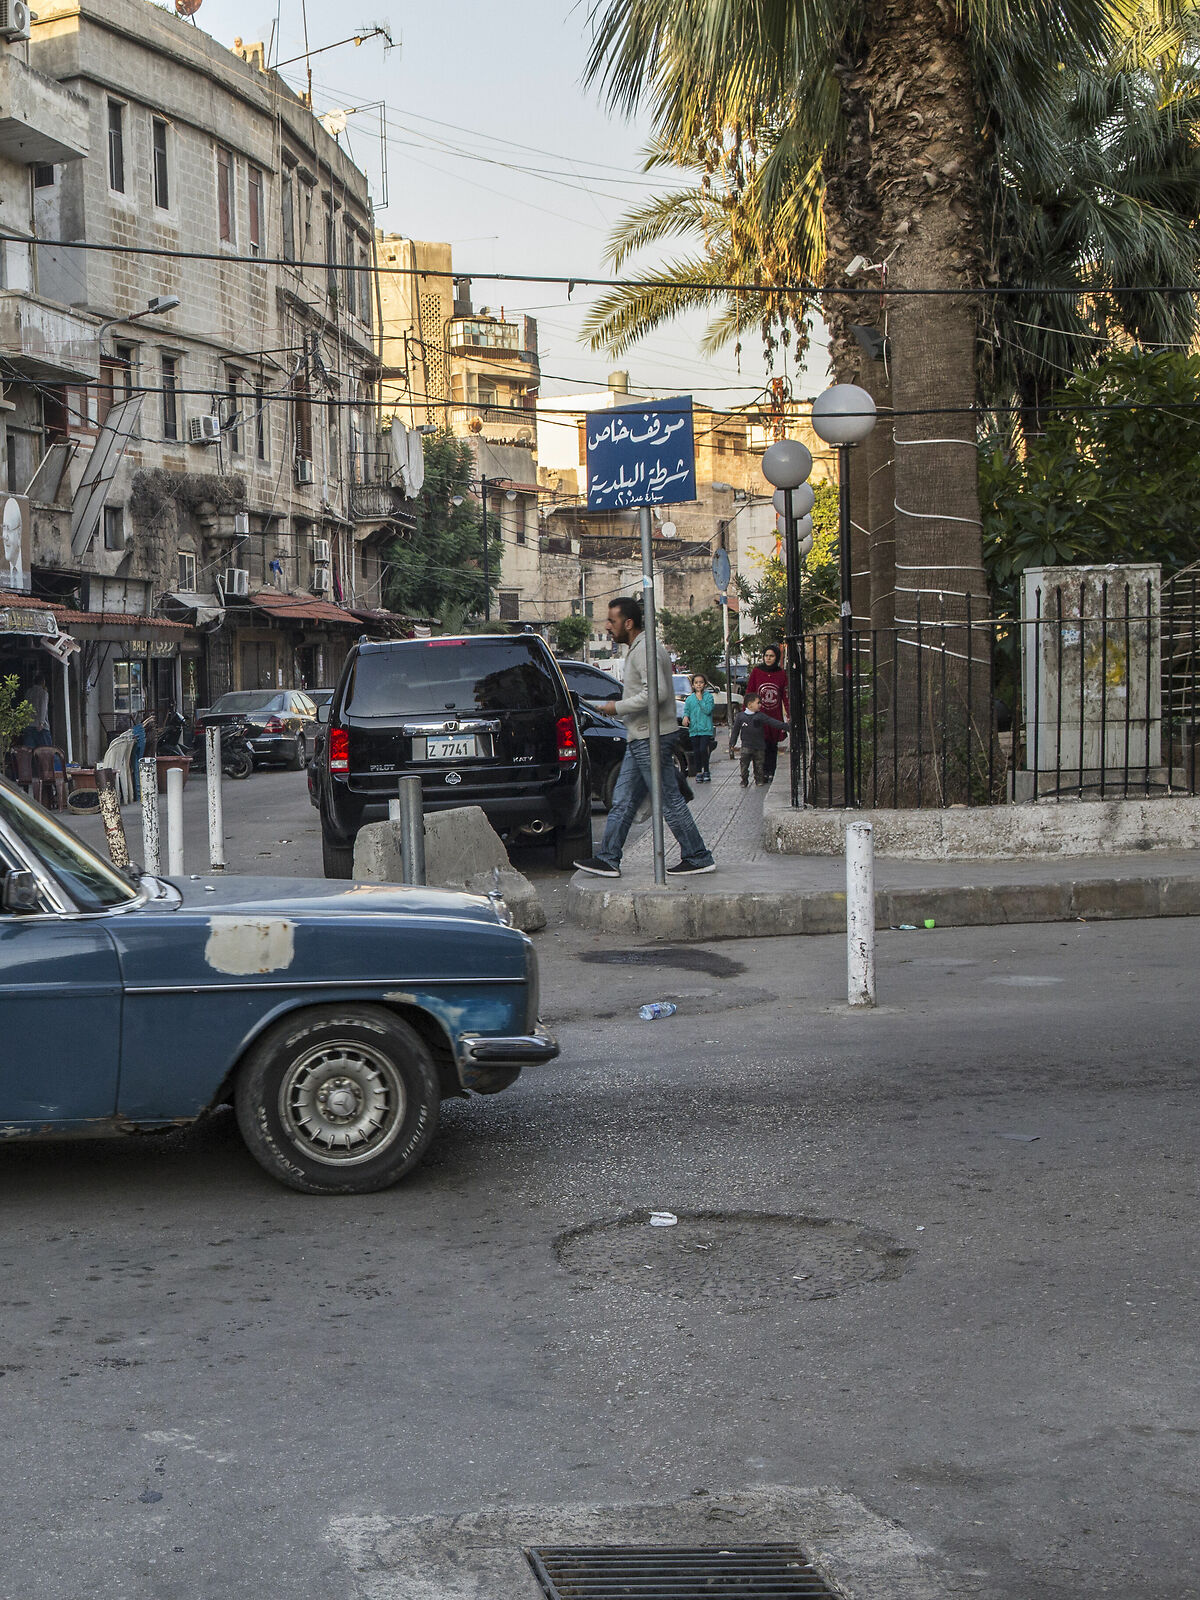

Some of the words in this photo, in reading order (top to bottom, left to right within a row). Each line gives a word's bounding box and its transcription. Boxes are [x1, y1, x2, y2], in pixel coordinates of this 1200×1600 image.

[587, 418, 630, 451] خاص
[630, 413, 685, 445] موقف
[589, 461, 645, 504] البلدية
[646, 459, 690, 493] شرطة
[429, 745, 437, 758] Z
[442, 743, 469, 757] 7741
